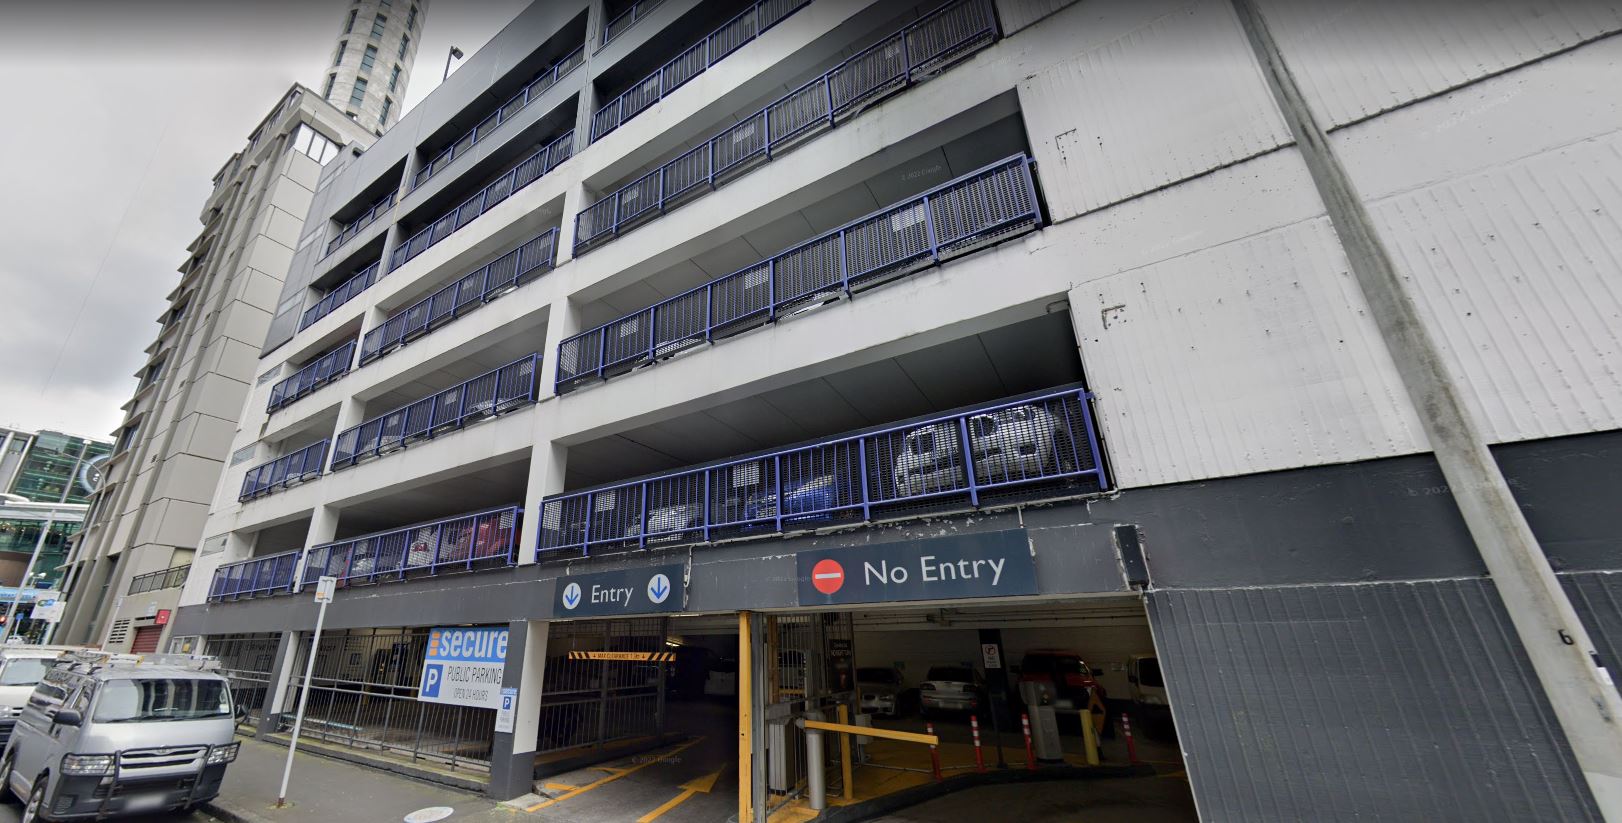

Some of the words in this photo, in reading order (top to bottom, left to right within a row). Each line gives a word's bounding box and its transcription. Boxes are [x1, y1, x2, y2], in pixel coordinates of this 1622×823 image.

[864, 558, 908, 586] No
[920, 554, 1006, 586] Entry
[591, 584, 633, 607] Entry
[440, 631, 508, 658] secure
[1558, 629, 1575, 645] 6
[426, 668, 438, 692] P
[447, 665, 471, 682] PUBLIC
[471, 667, 503, 685] PARKING
[453, 687, 465, 699] OPEN
[465, 688, 472, 700] 24
[472, 689, 489, 702] HOURS
[503, 697, 510, 708] P
